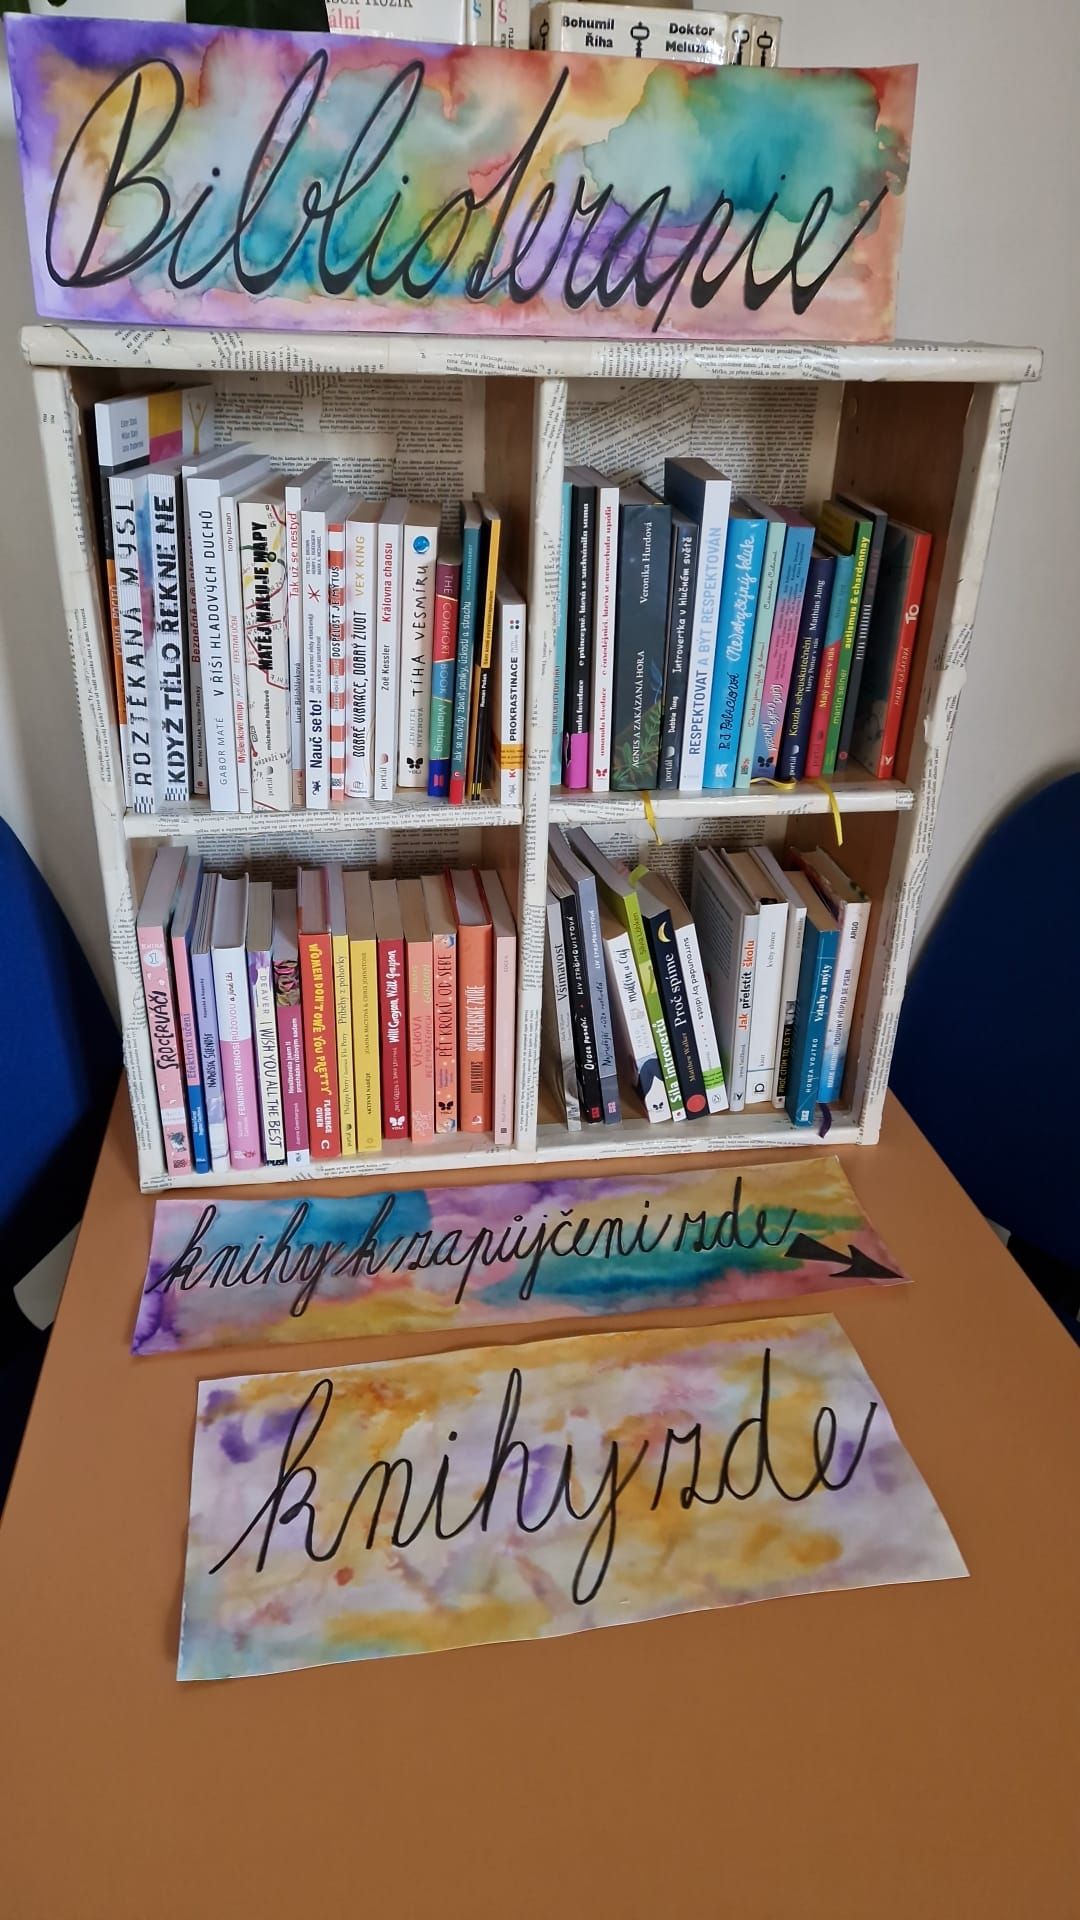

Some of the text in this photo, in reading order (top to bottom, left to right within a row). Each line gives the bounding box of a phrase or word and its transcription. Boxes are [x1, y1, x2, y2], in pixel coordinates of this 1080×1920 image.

[562, 16, 614, 30] Bohumil
[669, 22, 715, 36] Doktor
[585, 32, 613, 48] Říha
[46, 47, 890, 333] Biblioterapie
[198, 510, 214, 558] DUCHŮ
[640, 522, 652, 562] Hurdová
[682, 536, 692, 564] světě
[288, 552, 299, 598] Tak už se
[851, 536, 870, 594] chardonnay
[252, 522, 272, 670] MATĚJ MALUJE MAPY
[443, 575, 453, 594] THE
[640, 564, 650, 604] Veronika
[678, 568, 690, 606] hlučném
[204, 566, 221, 648] HLADOVÝCH
[380, 542, 392, 674] Kessler Královna chaosu
[412, 565, 428, 640] VESMÍRU
[726, 536, 757, 662] (Ne)obyčejný kluk
[224, 512, 244, 720] mapy tony buzan
[441, 602, 451, 654] COMFORT
[462, 602, 472, 628] strachu
[844, 606, 859, 648] autismus
[904, 604, 920, 624] TO
[114, 500, 152, 786] ROZTĚKANÁ MYSL
[154, 496, 186, 784] KDYŽ TĚLO ŘEKNE NE
[350, 536, 368, 758] DOBRÉ VIBRACE, DOBRÝ ŽIVOT VEX KING
[458, 640, 468, 664] úzkosti
[672, 618, 686, 673] Introvertka
[688, 527, 722, 754] RESPEKTOVAT A BÝT RESPEKTOVÁN
[810, 638, 820, 648] nás
[824, 647, 836, 660] nás
[207, 656, 223, 682] ŘÍŠI
[410, 654, 426, 696] TÍHA
[458, 666, 468, 690] paniky,
[636, 650, 645, 678] HORA
[788, 580, 824, 776] portál Kouzlo sebeuskutečnění Mathias Jung
[807, 656, 816, 674] Potter
[440, 664, 448, 694] BOOK
[805, 676, 815, 692] Harry
[822, 670, 834, 688] princ
[456, 692, 464, 712] zbavit
[510, 656, 518, 742] PROKRASTINACE
[633, 680, 644, 730] ZAKÁZANÁ
[669, 696, 680, 710] Tung
[818, 690, 830, 708] Malý
[832, 698, 842, 724] martin
[215, 718, 225, 746] MATÉ
[308, 700, 323, 768] Nauč se to!
[454, 716, 465, 740] navždy
[668, 712, 678, 732] Debbie
[434, 725, 444, 752] Haig
[454, 742, 463, 750] se
[216, 750, 228, 786] GABOR
[453, 750, 462, 762] Jak
[631, 740, 640, 768] AGNES
[664, 760, 674, 782] portál
[850, 921, 859, 940] ARGO
[438, 954, 452, 976] SEBE
[566, 916, 584, 995] LIV STRÖMQUISTOVÁ
[224, 972, 233, 982] lži
[336, 956, 347, 988] pohovky
[552, 944, 568, 1001] Všímavost
[683, 936, 704, 1020] surrounded by idiots
[738, 940, 754, 1030] Jak přelstít školu
[819, 964, 832, 986] mýty
[842, 969, 851, 986] PSEM
[226, 982, 238, 996] jiné
[260, 976, 270, 1014] DEAVER
[386, 980, 398, 998] Will
[438, 982, 452, 996] OD
[622, 972, 638, 1002] muffin
[308, 944, 332, 1096] WOMEN DON'T OWE YOU PRETTY
[336, 996, 348, 1024] Příběhy
[388, 998, 401, 1028] Grayson,
[436, 1002, 452, 1036] KROKŮ
[464, 984, 486, 1052] SPOLEČENSKÉ ZVÍŘE
[663, 952, 696, 1082] Matthew Walker Proč spíme
[814, 994, 828, 1022] Vztahy
[836, 996, 848, 1018] PŘÍPAD
[148, 990, 179, 1070] SRDCERVÁČI
[228, 1004, 240, 1042] RŮŽOVOU
[386, 1028, 400, 1043] Will
[784, 1028, 791, 1036] TY
[833, 1020, 843, 1046] PODIVNÝ
[182, 1012, 196, 1079] Efektivní učení
[259, 1028, 274, 1052] WISH
[412, 1016, 424, 1068] VÝCHOVA
[436, 1042, 452, 1057] PĚT
[782, 1037, 790, 1046] CO
[809, 1038, 818, 1066] VOJTKO
[232, 1042, 242, 1070] NENOSÍ
[263, 1054, 276, 1078] YOU
[652, 1018, 682, 1102] Síla introvertů
[778, 1058, 786, 1076] CÍTÍM
[234, 1072, 246, 1116] FEMINISTKY
[265, 1080, 278, 1096] ALL
[778, 1076, 786, 1093] PROČ
[805, 1069, 814, 1093] HONZA
[267, 1099, 278, 1116] THE
[324, 1100, 332, 1133] FLORENCE
[268, 1120, 282, 1146] BEST
[144, 1203, 342, 1318] knihy
[335, 1192, 405, 1278] k
[674, 1176, 798, 1253] zde
[209, 1346, 880, 1606] knihy zde
